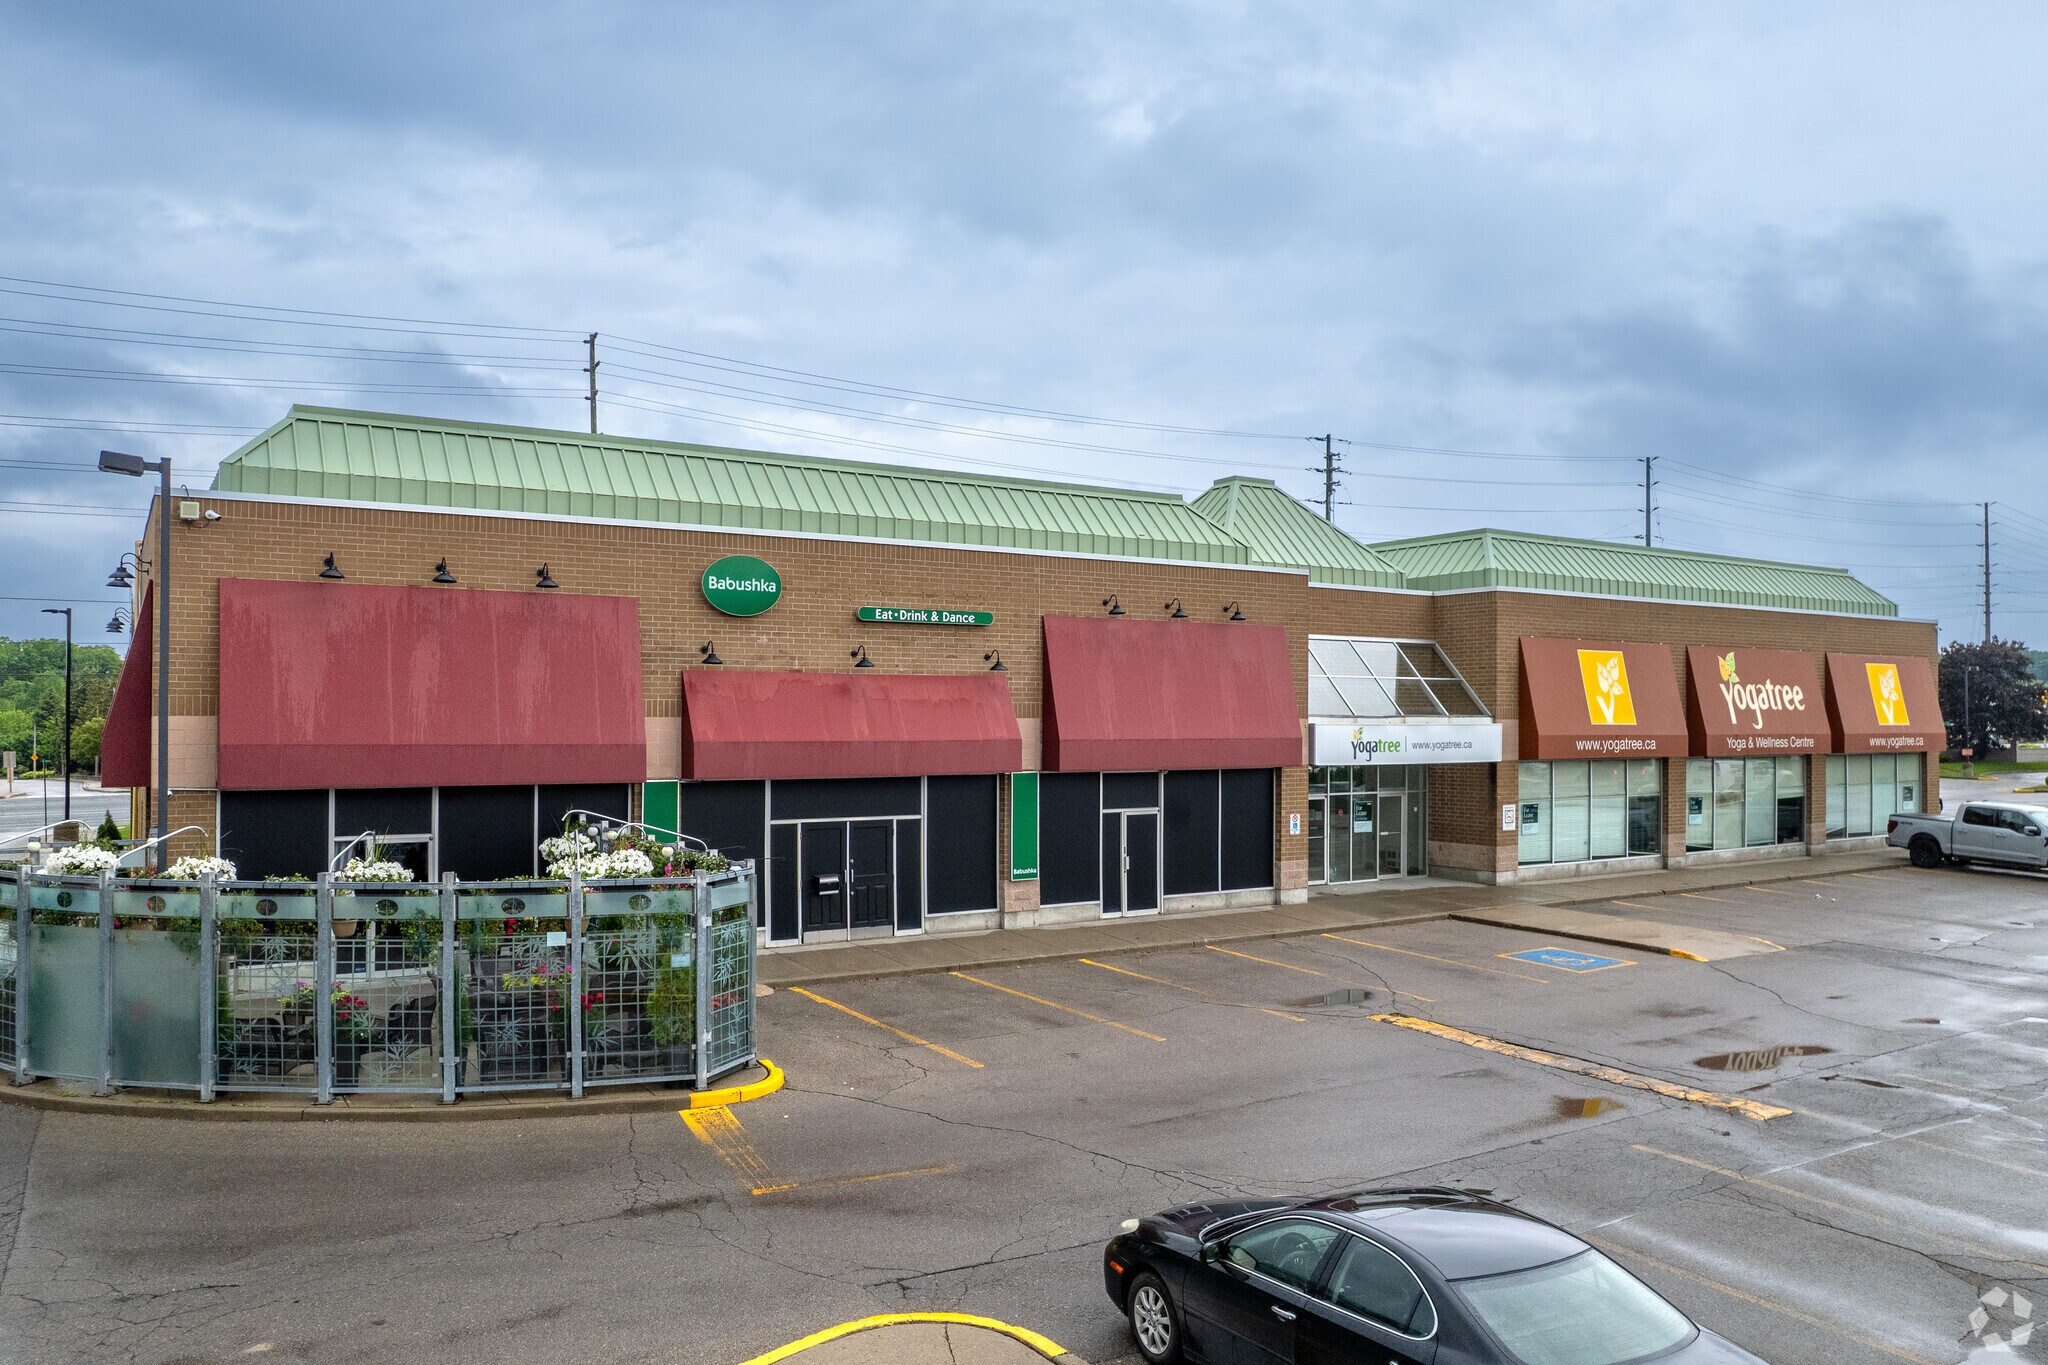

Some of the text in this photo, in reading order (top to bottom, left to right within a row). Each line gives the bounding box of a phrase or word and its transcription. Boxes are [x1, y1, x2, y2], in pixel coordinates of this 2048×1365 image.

[708, 576, 776, 593] Babushka
[931, 612, 939, 622] &
[942, 612, 976, 623] Dance
[1411, 741, 1473, 751] www.yogatree.ca
[1576, 738, 1656, 753] www.yogatree.ca
[1726, 737, 1815, 750] Yoga & Wellness Centre
[1870, 736, 1923, 748] www.yogatree.ca
